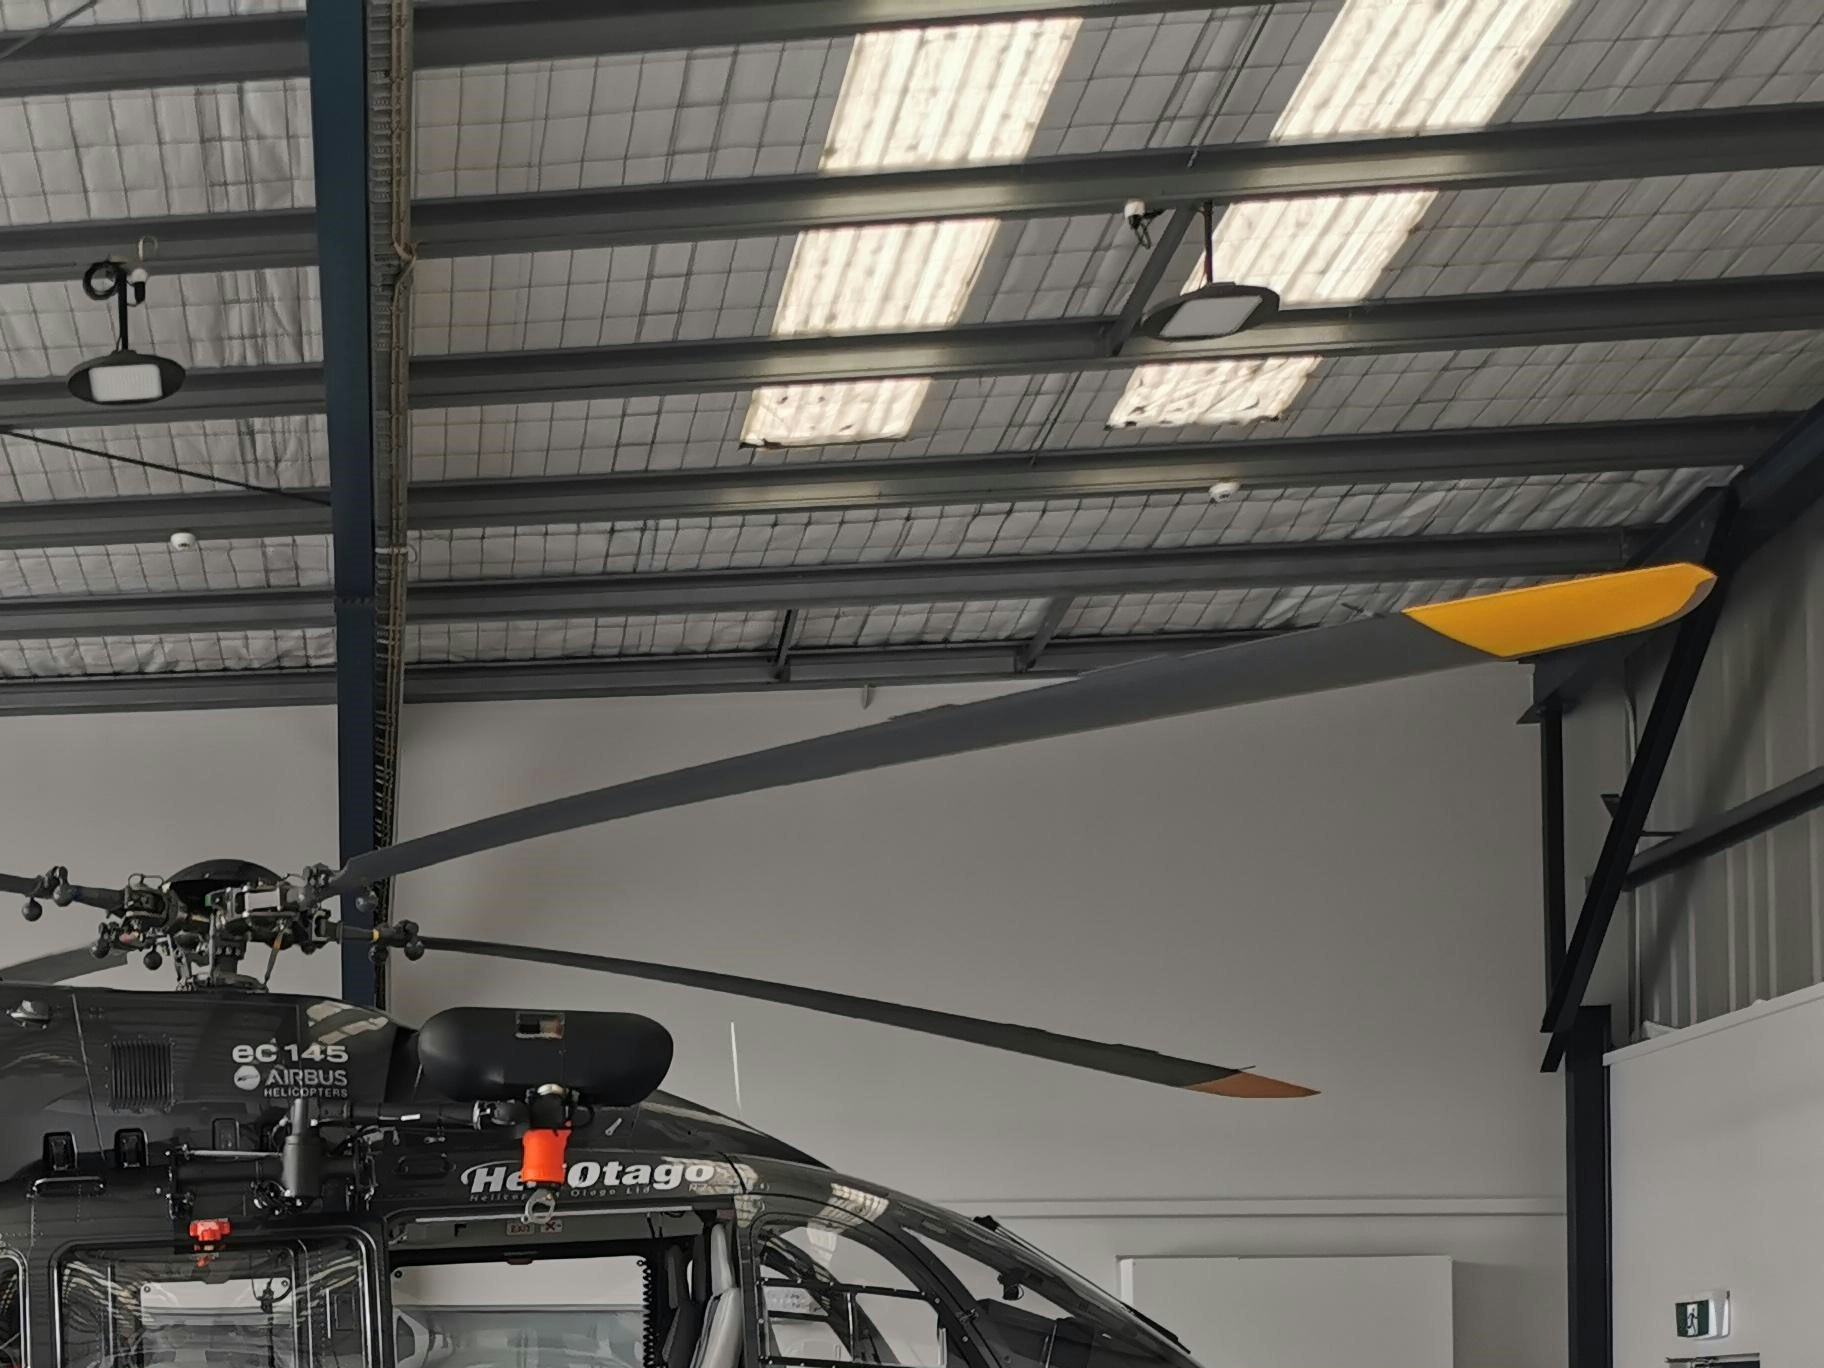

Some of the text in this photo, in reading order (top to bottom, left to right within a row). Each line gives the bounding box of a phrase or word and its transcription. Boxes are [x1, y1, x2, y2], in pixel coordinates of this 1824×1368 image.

[282, 1042, 349, 1063] 145
[264, 1068, 348, 1087] AIRBUS
[263, 1087, 348, 1098] HELICOPTERS
